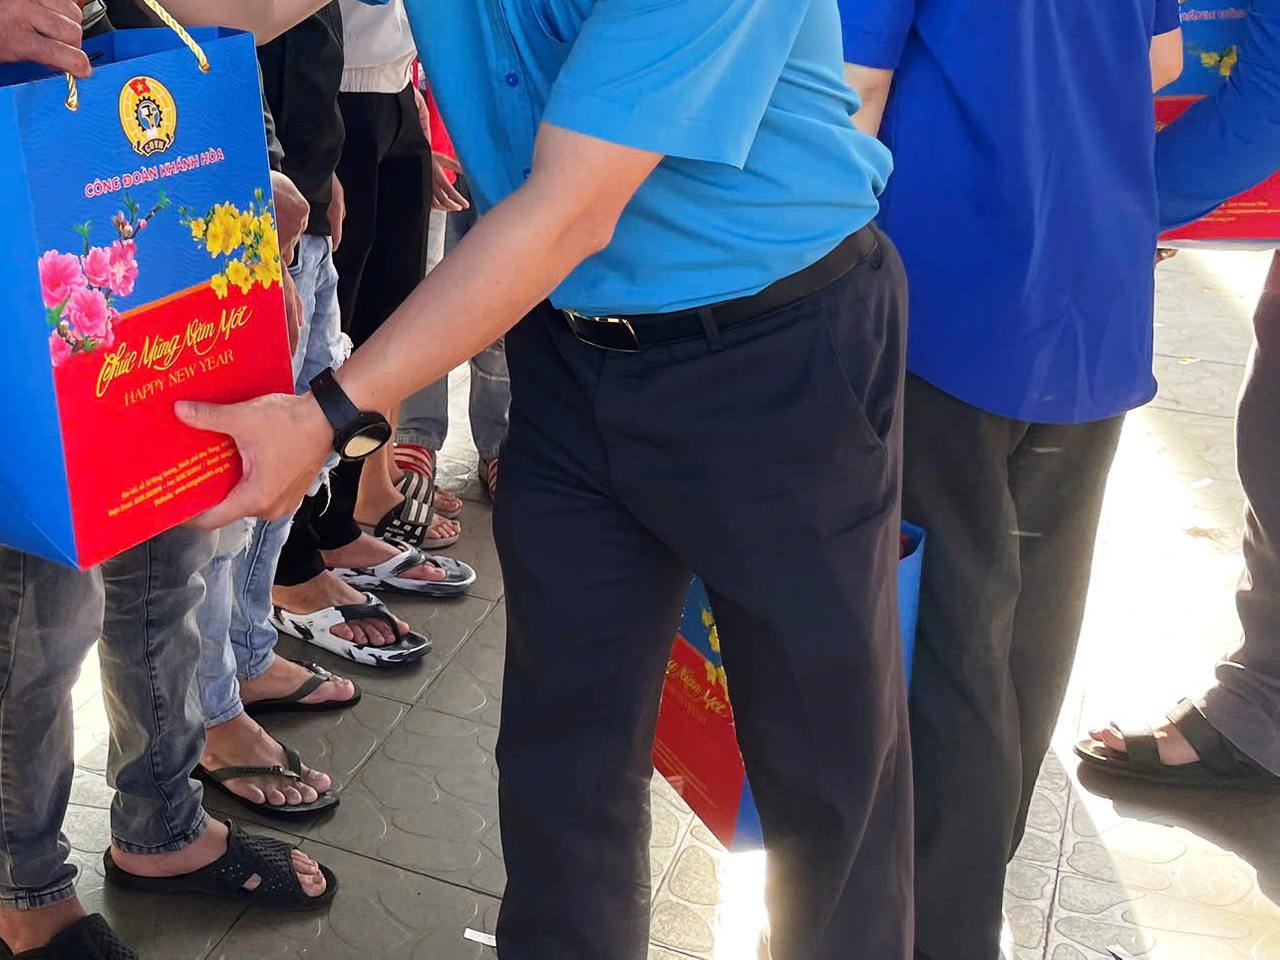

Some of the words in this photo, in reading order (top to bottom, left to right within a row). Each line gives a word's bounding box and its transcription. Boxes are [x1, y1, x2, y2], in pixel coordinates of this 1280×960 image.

[84, 177, 122, 198] CÔNG
[122, 166, 159, 188] ĐOÀN
[159, 155, 200, 178] KHÁNH
[200, 147, 225, 166] HÒA
[95, 341, 138, 398] Chúc
[137, 333, 181, 371] Mừng
[185, 318, 216, 352] Năm
[219, 305, 253, 341] Mới
[124, 377, 166, 407] HAPPY
[169, 363, 197, 387] NEW
[199, 348, 235, 373] YEAR
